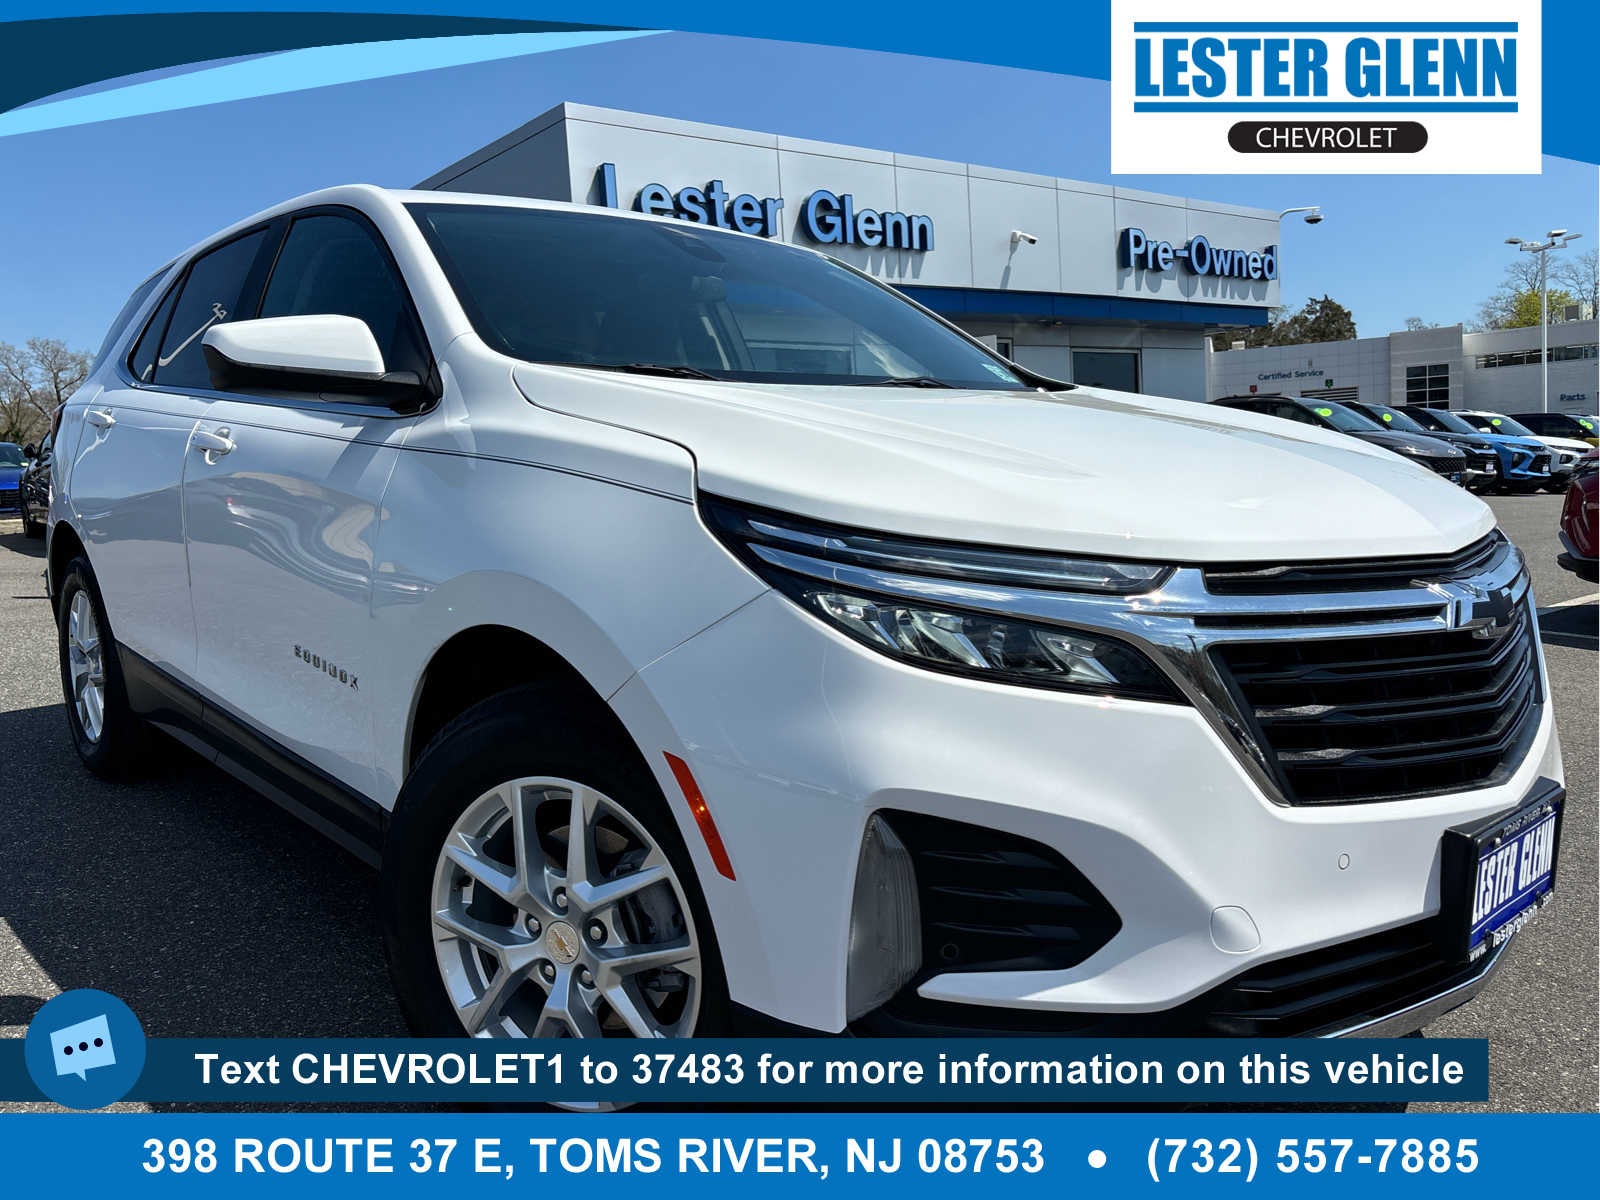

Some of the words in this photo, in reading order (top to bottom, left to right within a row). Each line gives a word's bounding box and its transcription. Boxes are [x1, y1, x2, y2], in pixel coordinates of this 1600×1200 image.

[598, 162, 785, 237] Lester
[802, 189, 936, 251] Glenn
[1121, 227, 1278, 280] Pre-Owned
[1258, 371, 1292, 381] Certified
[1294, 369, 1324, 378] Service
[1559, 392, 1586, 401] Parts
[293, 644, 359, 691] EQUINOX
[1472, 841, 1519, 926] LESTER
[1518, 815, 1556, 891] GLENN
